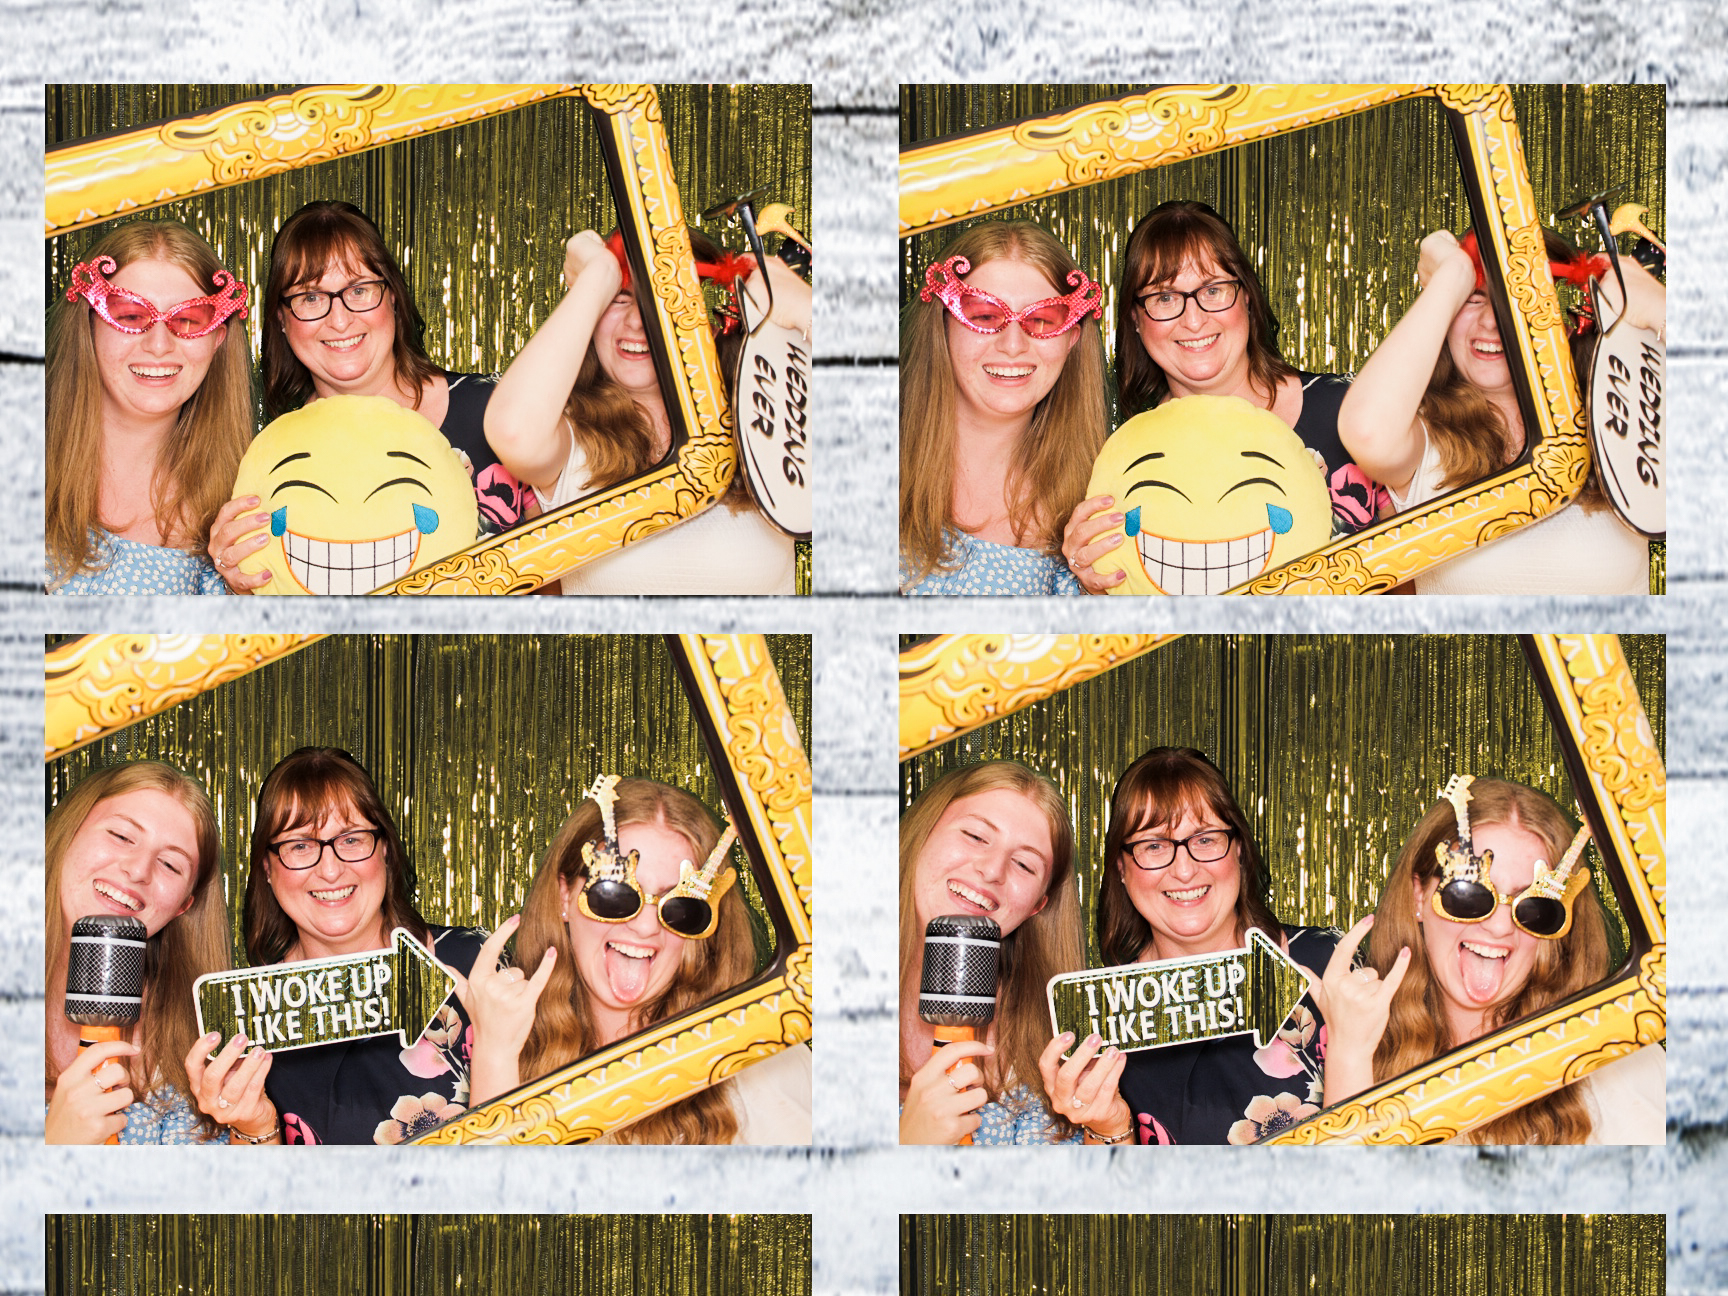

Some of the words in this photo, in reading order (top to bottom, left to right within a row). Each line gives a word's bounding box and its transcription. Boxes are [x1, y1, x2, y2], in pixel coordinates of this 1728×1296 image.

[751, 354, 777, 439] EVER
[783, 342, 808, 488] WEDDING
[1605, 354, 1631, 439] EVER
[1637, 342, 1662, 488] WEDDING
[231, 984, 246, 1016] I
[249, 969, 346, 1014] WOKE
[351, 964, 393, 999] UP
[238, 1010, 304, 1047] LIKE
[309, 997, 391, 1036] THIS!
[1085, 984, 1100, 1016] I
[1103, 969, 1200, 1014] WOKE
[1205, 964, 1247, 999] UP
[1092, 1010, 1158, 1047] LIKE
[1163, 997, 1245, 1036] THIS!
